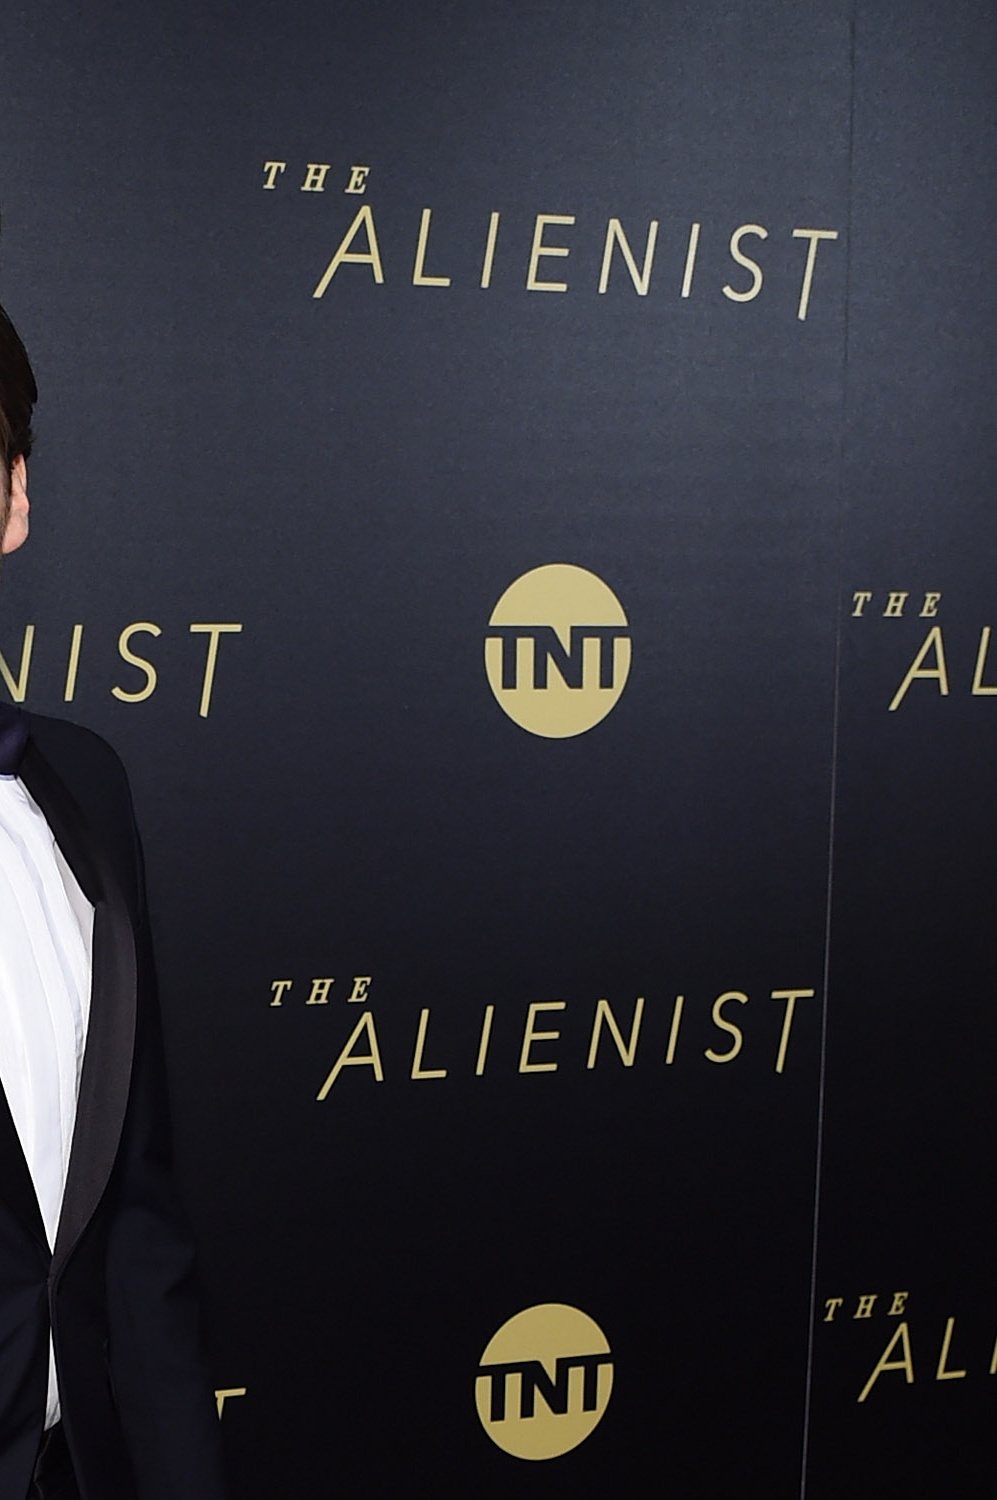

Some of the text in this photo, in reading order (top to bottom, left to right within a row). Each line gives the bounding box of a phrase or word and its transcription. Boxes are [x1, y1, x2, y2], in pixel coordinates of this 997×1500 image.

[264, 161, 369, 193] THE
[314, 205, 837, 317] ALIENIST
[853, 591, 941, 617] THE
[485, 625, 631, 690] TNT
[271, 977, 372, 1006] THE
[317, 989, 814, 1101] ALIENIST
[824, 1292, 909, 1322] THE
[476, 1353, 613, 1423] TNT
